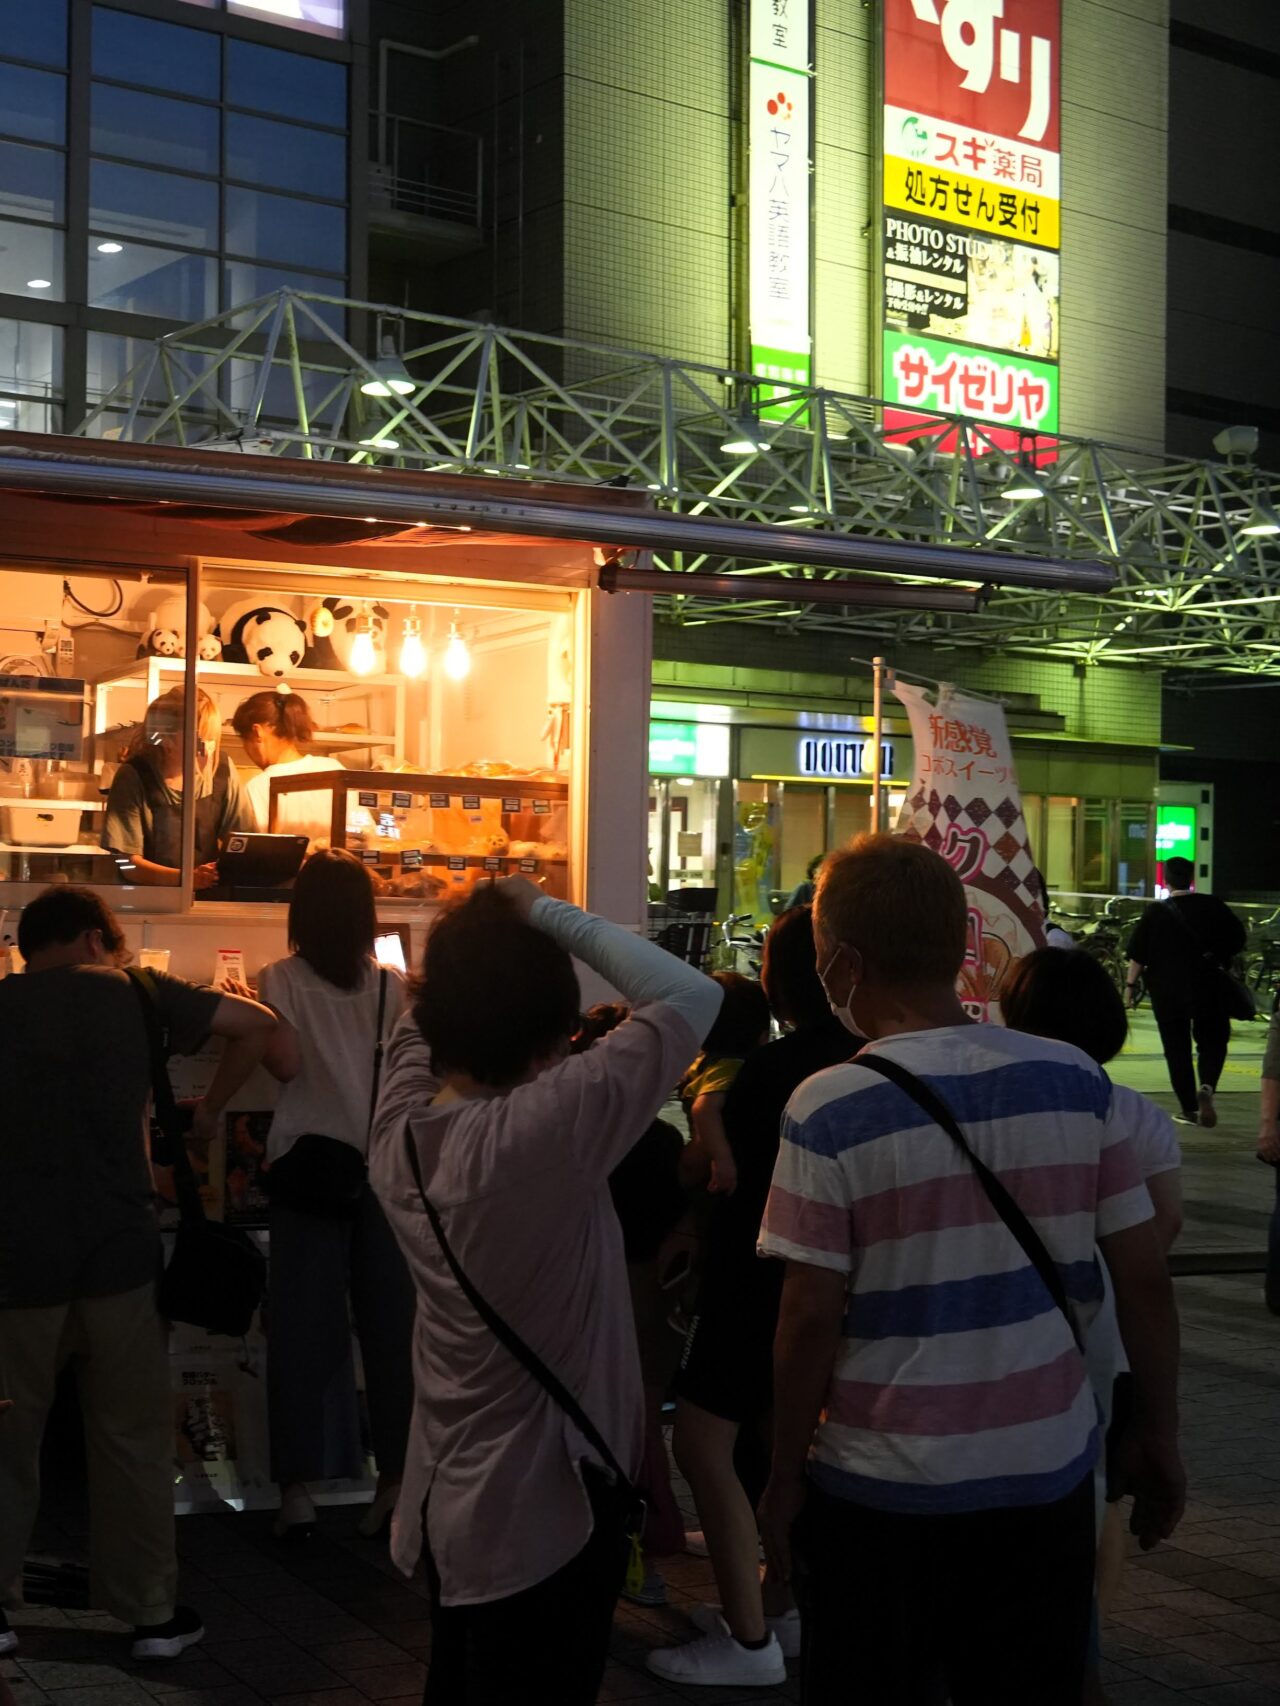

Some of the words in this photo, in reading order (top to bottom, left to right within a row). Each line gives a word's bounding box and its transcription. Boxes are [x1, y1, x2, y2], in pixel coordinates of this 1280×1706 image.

[934, 131, 1044, 189] スギ薬局
[768, 126, 792, 301] ヤマハ英語教室
[905, 166, 1041, 236] 処方せん受付
[885, 218, 944, 249] PHOTO
[899, 352, 1044, 421] サイゼリヤ
[927, 713, 998, 758] 新感覚
